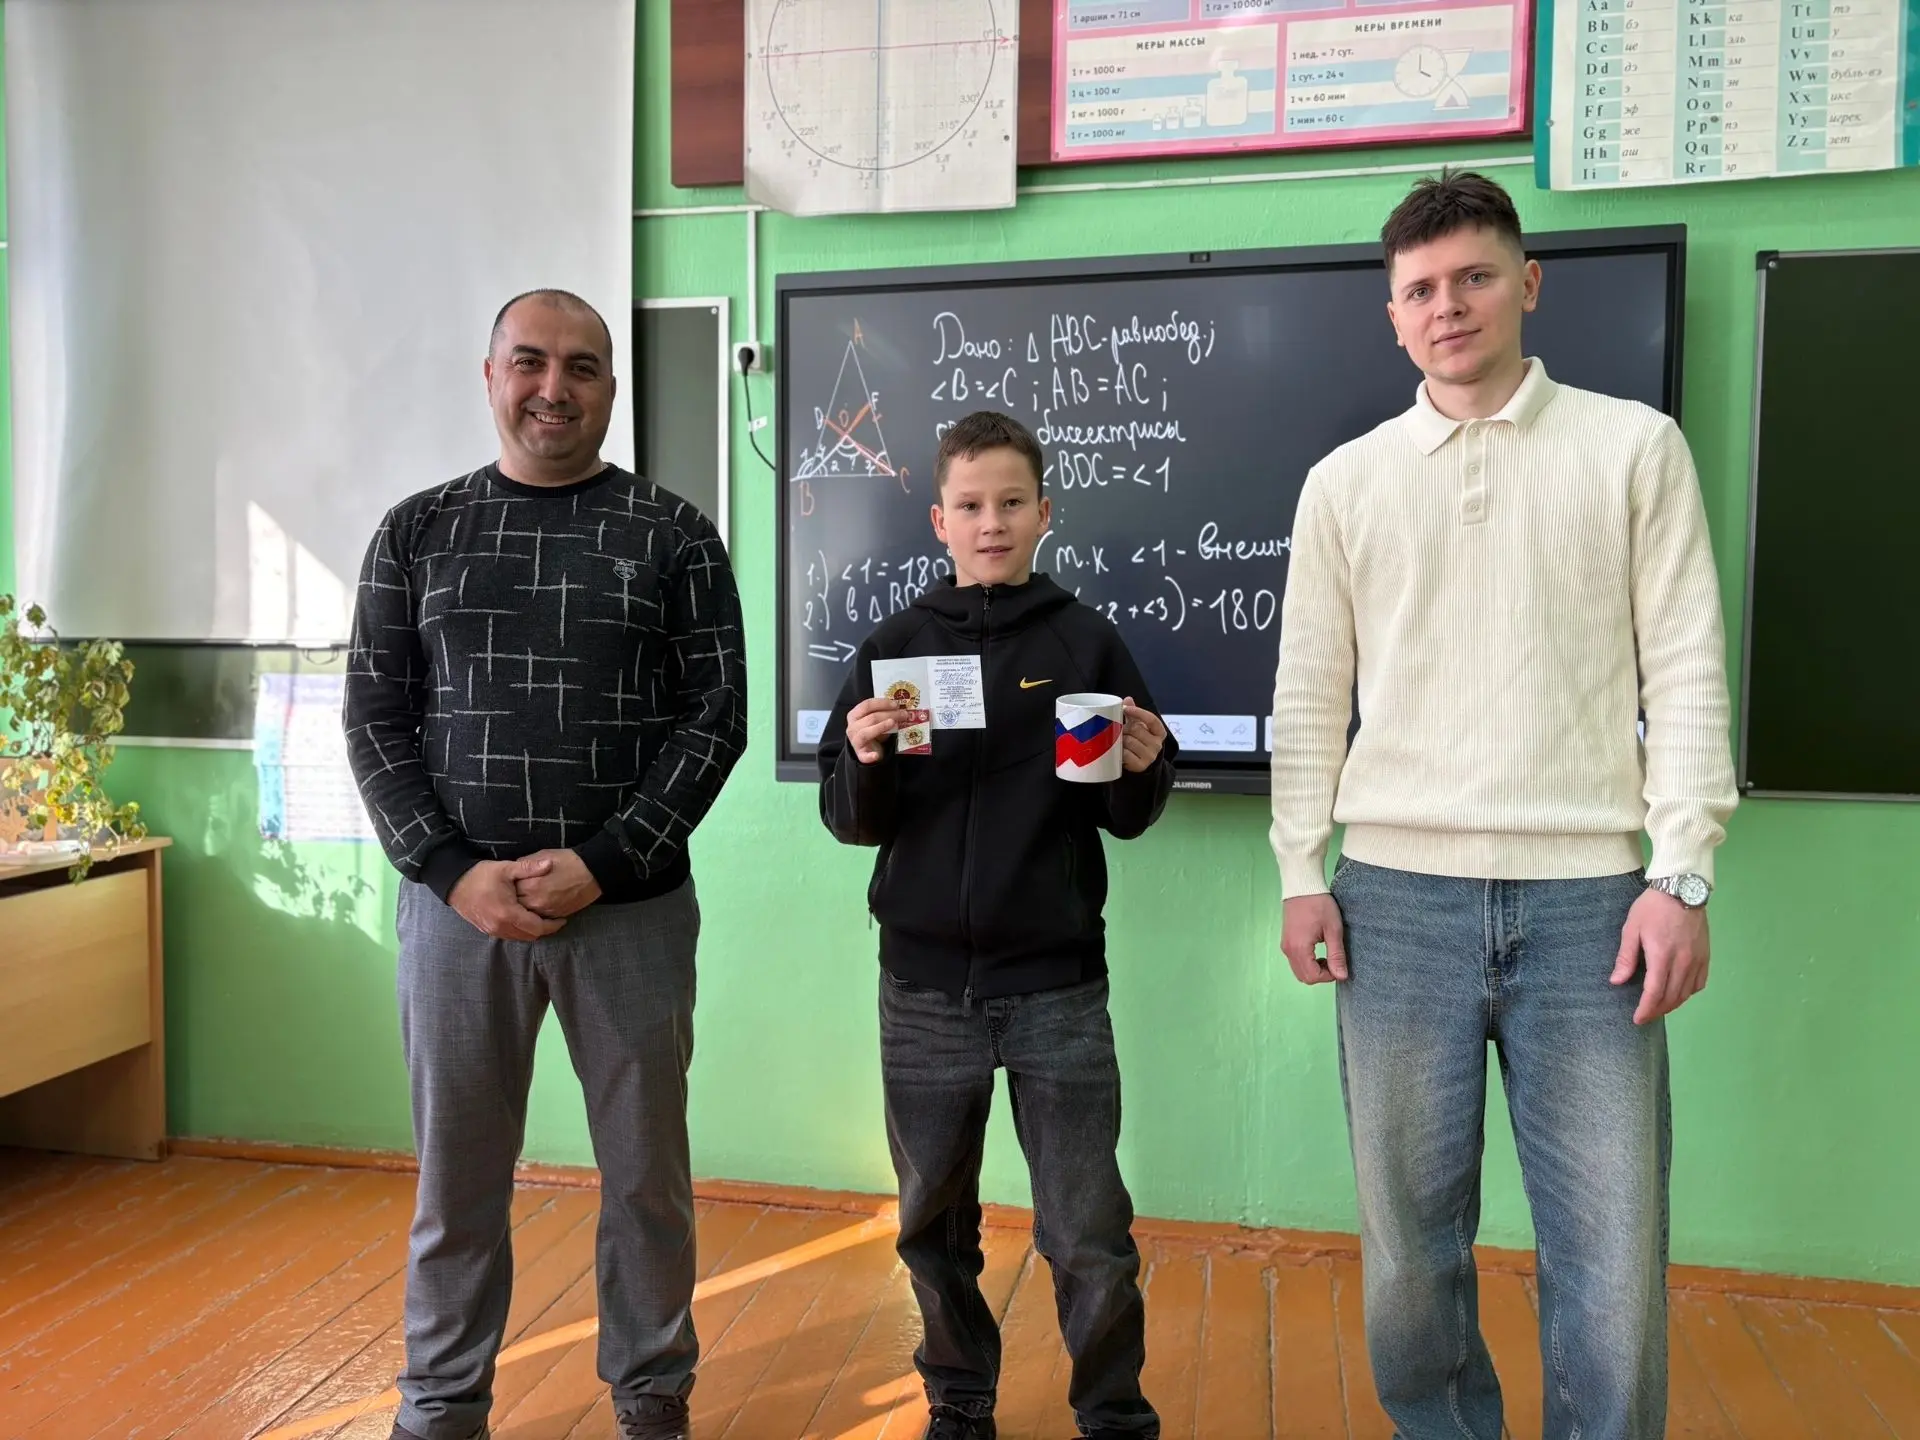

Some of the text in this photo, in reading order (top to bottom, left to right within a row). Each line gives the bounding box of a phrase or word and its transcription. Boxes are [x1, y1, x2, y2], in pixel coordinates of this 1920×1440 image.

[1080, 14, 1108, 23] аршин
[1119, 11, 1127, 19] 71
[1355, 18, 1442, 32] МЕРЫ ВРЕМЕНИ
[1136, 37, 1205, 50] МЕРЫ МАССЫ
[1094, 65, 1115, 75] 1000
[1326, 70, 1336, 79] 24
[1094, 87, 1110, 96] 100
[1313, 93, 1325, 102] 60
[1098, 108, 1119, 117] 1000
[1325, 114, 1337, 123] 60
[1093, 129, 1114, 138] 1000
[933, 312, 1013, 365] Дано:
